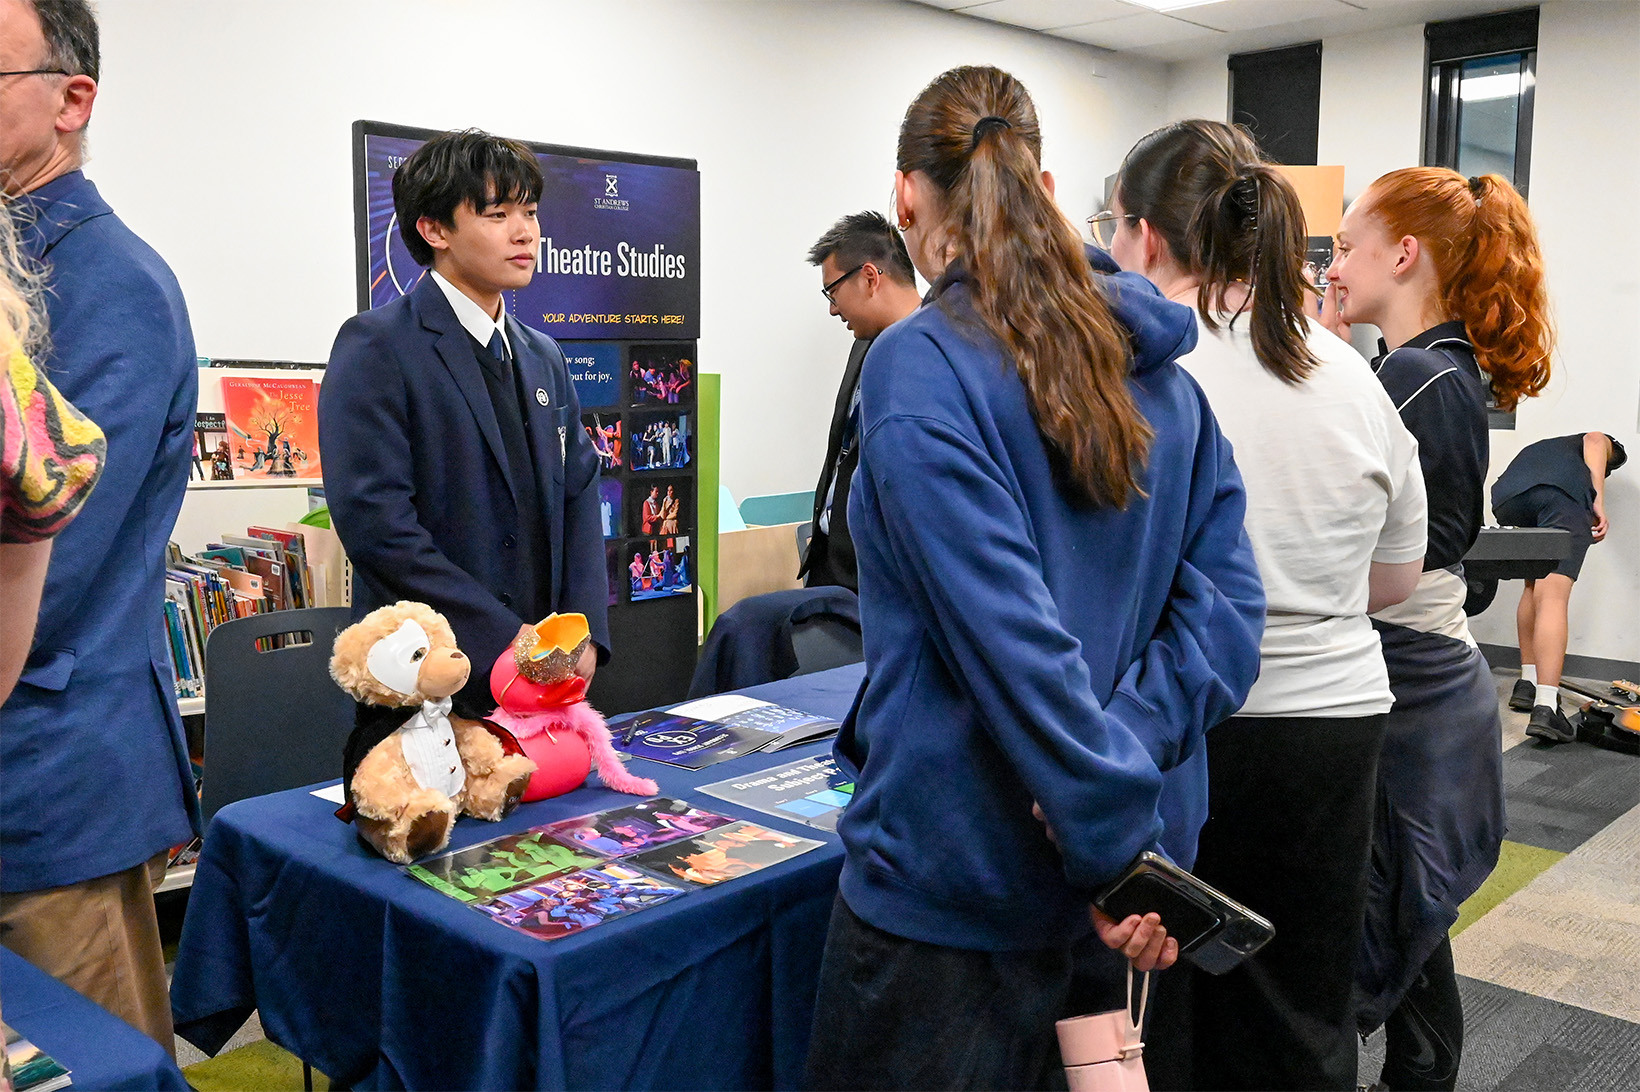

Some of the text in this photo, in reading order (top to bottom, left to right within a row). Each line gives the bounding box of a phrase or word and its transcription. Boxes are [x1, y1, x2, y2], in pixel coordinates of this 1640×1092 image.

[537, 237, 686, 280] Theatre Studies
[542, 312, 686, 325] YOUR ADVENTURE STARTS HERE!
[574, 357, 595, 367] song;
[585, 370, 597, 381] for
[598, 371, 613, 383] joy.
[279, 390, 304, 401] Jesse
[289, 401, 311, 412] Tree
[732, 775, 778, 790] Drama
[777, 768, 802, 778] and
[767, 772, 829, 791] Subject
